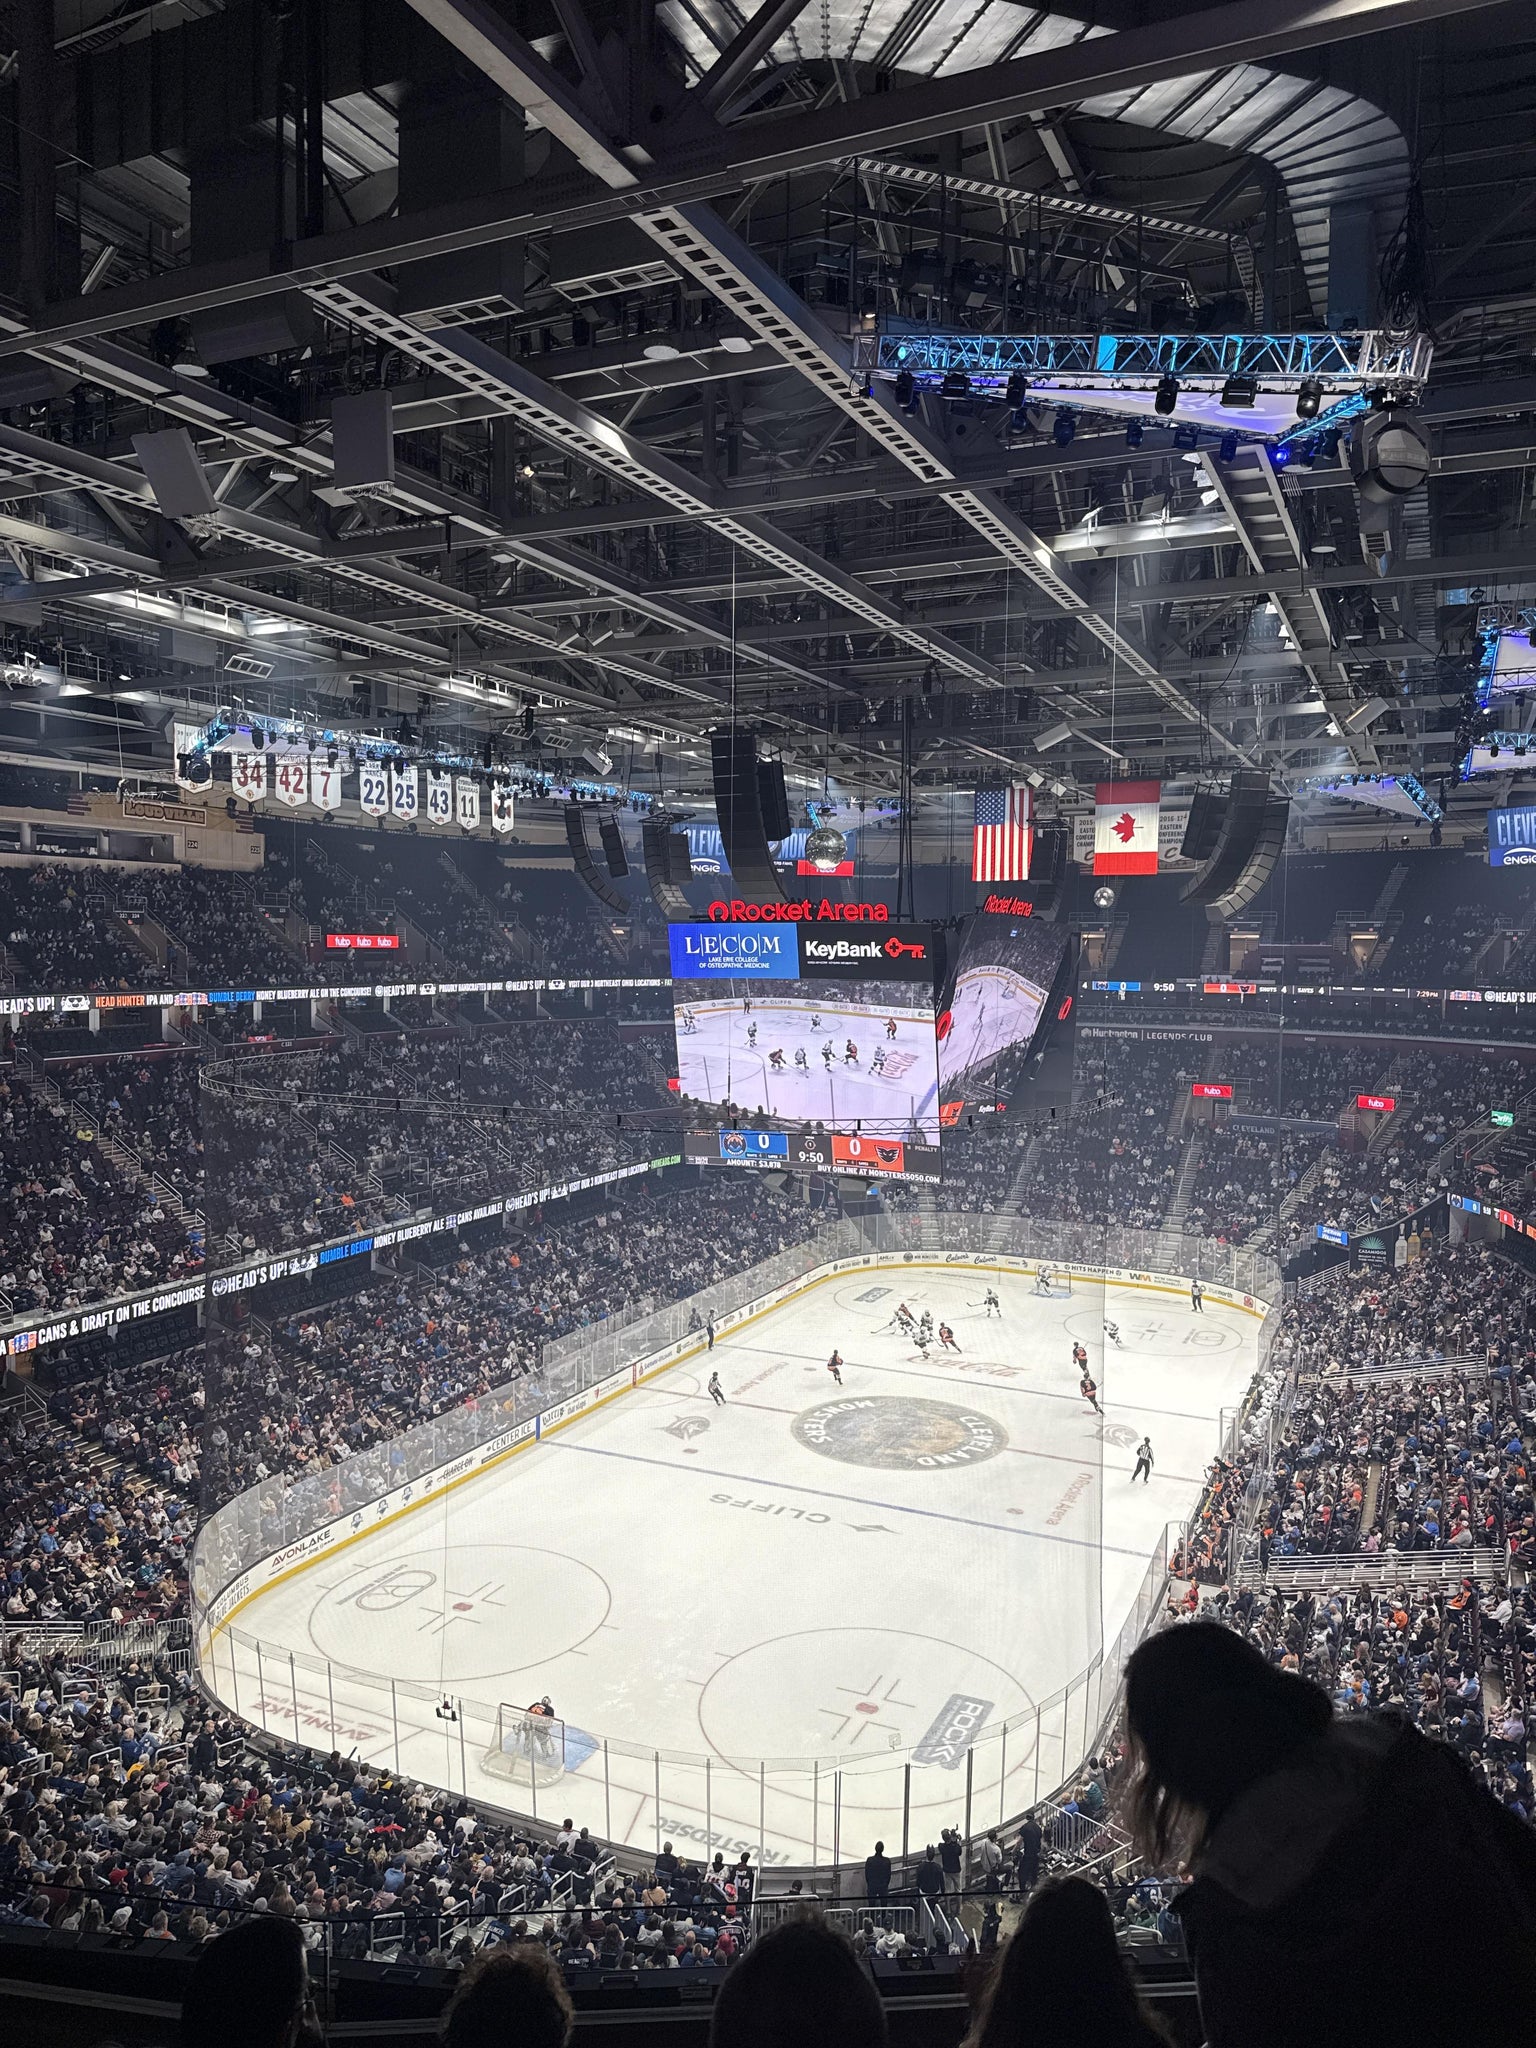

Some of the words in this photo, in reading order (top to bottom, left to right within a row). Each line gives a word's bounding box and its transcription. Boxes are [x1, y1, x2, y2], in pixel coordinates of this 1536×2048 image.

[237, 761, 263, 788] 34
[279, 765, 304, 794] 42
[320, 771, 331, 797] 7
[363, 778, 386, 806] 22
[395, 784, 416, 810] 25
[429, 789, 449, 815] 43
[125, 802, 205, 824] LOUDVILLE
[461, 795, 476, 819] 11
[732, 899, 812, 922] Rocket
[816, 899, 889, 922] Arena
[1009, 897, 1033, 918] Arena
[335, 937, 351, 946] fubo
[356, 937, 372, 946] fubo
[377, 937, 392, 946] fubo
[805, 940, 883, 960] KeyBank
[208, 991, 234, 1003] BUMBLE
[235, 991, 256, 1001] BERRY
[256, 990, 276, 1000] HONEY
[276, 989, 309, 1000] BLUEBERRY
[309, 988, 320, 998] ALE
[320, 988, 329, 998] ON
[329, 987, 340, 997] THE
[340, 986, 372, 997] CONCOURSE!
[383, 984, 406, 997] HEAD'S
[406, 984, 417, 995] UP!
[512, 981, 534, 992] HEAD'S
[535, 980, 546, 990] UP!
[1082, 982, 1088, 990] 4
[1120, 982, 1127, 991] 0
[1153, 982, 1175, 992] 9:50
[1220, 984, 1227, 993] 0
[1281, 985, 1287, 994] 4
[1318, 986, 1325, 995] 4
[36, 996, 55, 1011] UP!
[95, 997, 116, 1008] HEAD
[117, 995, 145, 1007] HUNTER
[146, 995, 158, 1006] IPA
[159, 994, 174, 1005] AND
[1495, 991, 1526, 1003] HEAD'S
[1146, 1031, 1187, 1040] LEGENDS
[1189, 1032, 1213, 1041] CLUB
[1204, 1086, 1221, 1095] fubo
[1367, 1098, 1385, 1108] fubo
[758, 1134, 770, 1149] 0
[849, 1139, 861, 1156] 0
[726, 1158, 757, 1168] AMOUNT:
[798, 1151, 824, 1163] 9:50
[817, 1164, 831, 1173] BUY
[832, 1166, 857, 1176] ONLINE
[859, 1168, 867, 1176] AT
[868, 1169, 940, 1184] MONSTERS5050.COM
[515, 1191, 539, 1210] HEAD'S
[539, 1187, 551, 1203] UP!
[319, 1245, 350, 1265] BUMBLE
[350, 1237, 374, 1256] BERRY
[374, 1231, 397, 1249] HONEY
[396, 1221, 433, 1242] BLUEBERRY
[433, 1218, 445, 1233] ALE
[457, 1210, 473, 1225] CANS
[473, 1202, 503, 1220] AVAILABLE!
[945, 1253, 970, 1263] Culver's
[974, 1255, 998, 1265] Culver's
[227, 1267, 267, 1293] HEAD'S
[269, 1260, 288, 1282] UP!
[1087, 1267, 1115, 1275] HAPPEN
[1129, 1272, 1152, 1283] WM
[38, 1321, 67, 1345] CANS
[69, 1317, 80, 1335] &
[81, 1309, 115, 1333] DRAFT
[116, 1305, 130, 1323] ON
[133, 1299, 151, 1319] THE
[152, 1285, 206, 1313] CONCOURSE
[804, 1399, 876, 1445] MONSTERS
[491, 1427, 520, 1452] CENTER
[520, 1422, 532, 1436] ICE
[917, 1415, 995, 1466] CLEVELAND
[709, 1492, 832, 1524] CLIFFS
[216, 1574, 249, 1610] COLUMBUS
[649, 1815, 791, 1866] TRUSTEDSEC
